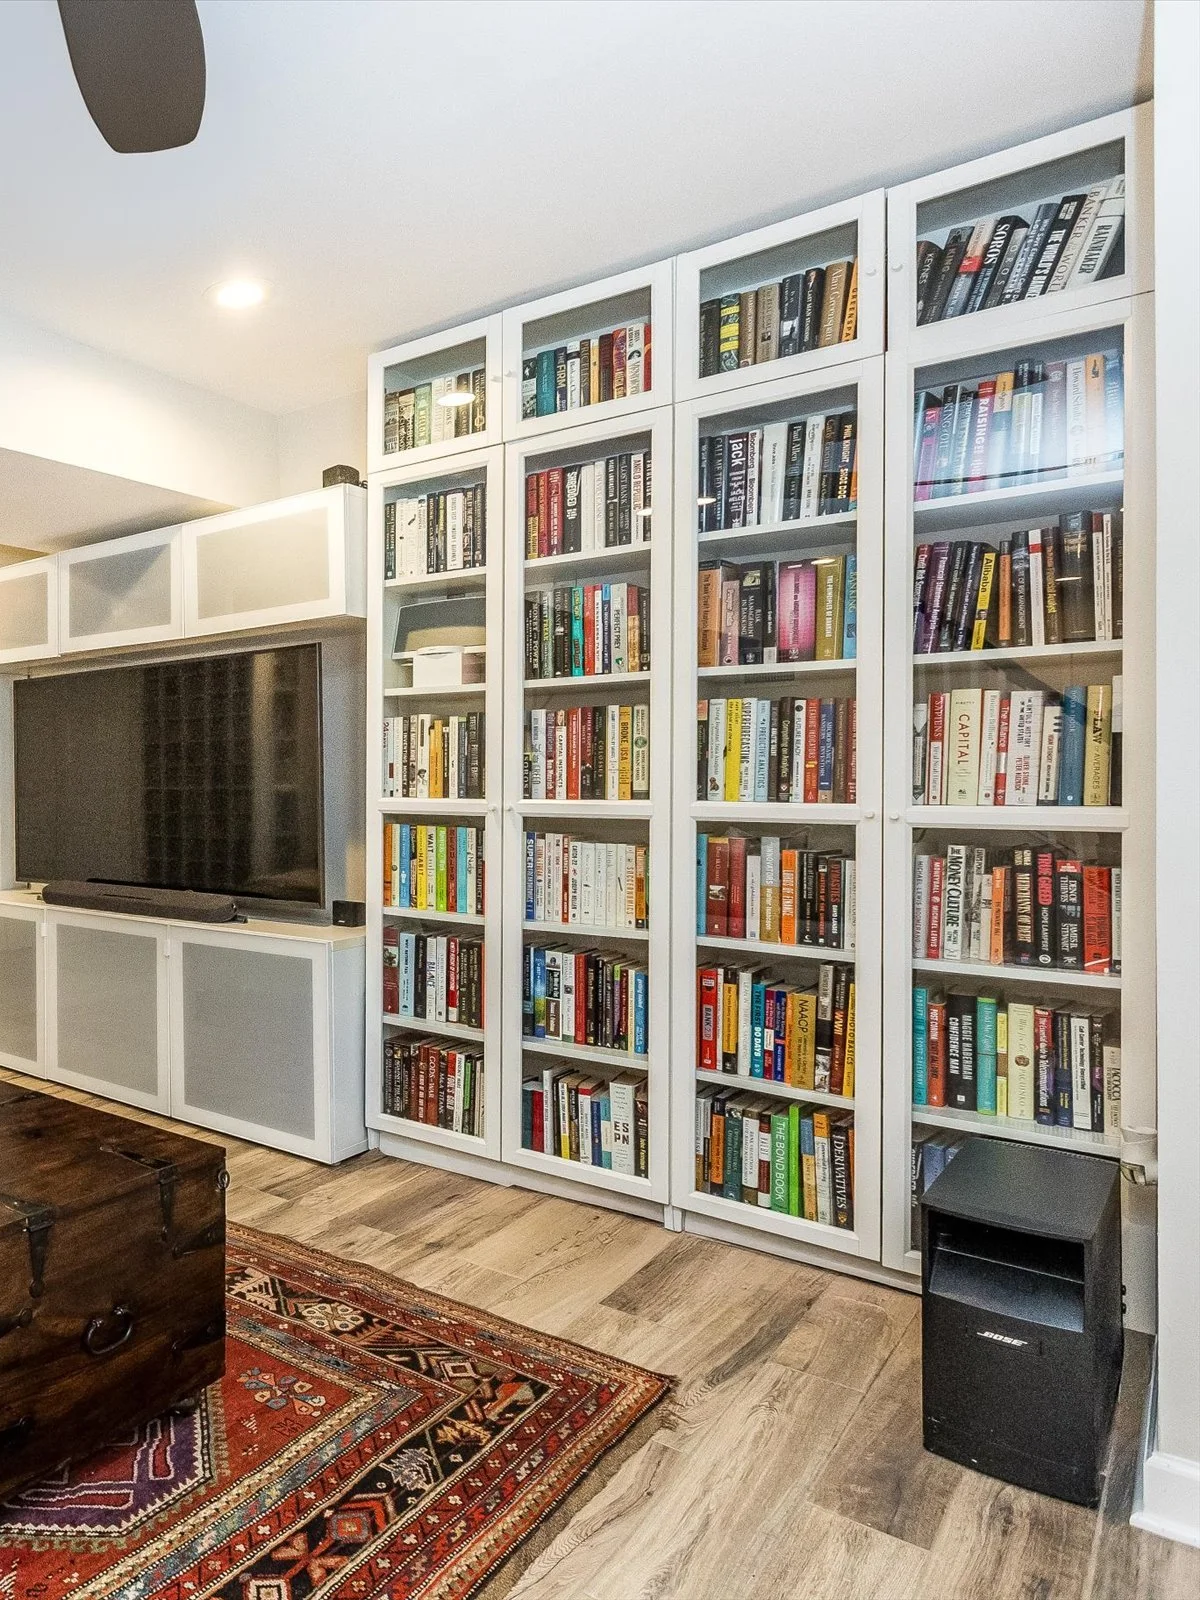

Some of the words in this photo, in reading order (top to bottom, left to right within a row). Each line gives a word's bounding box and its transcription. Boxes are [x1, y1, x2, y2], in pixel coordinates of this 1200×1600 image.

[983, 223, 1010, 265] SOROS
[918, 253, 934, 284] KEYNES
[845, 288, 857, 342] GREENSPA
[974, 398, 989, 444] RAISING
[729, 438, 746, 466] jack
[980, 558, 993, 593] Alibaba
[958, 714, 970, 765] CAPITAL
[948, 856, 962, 888] MONEY
[946, 888, 962, 927] CULTURE
[798, 1000, 808, 1033] NAACP
[962, 1015, 972, 1041] MAGGIE
[949, 1018, 959, 1056] CONFIDENCE
[949, 1058, 958, 1074] MAN
[962, 1043, 972, 1080] HABERMAN
[775, 1143, 785, 1170] BOND
[775, 1173, 785, 1201] BOOK
[833, 1140, 846, 1209] DERIVATIVES
[977, 1331, 1028, 1347] BOSE
